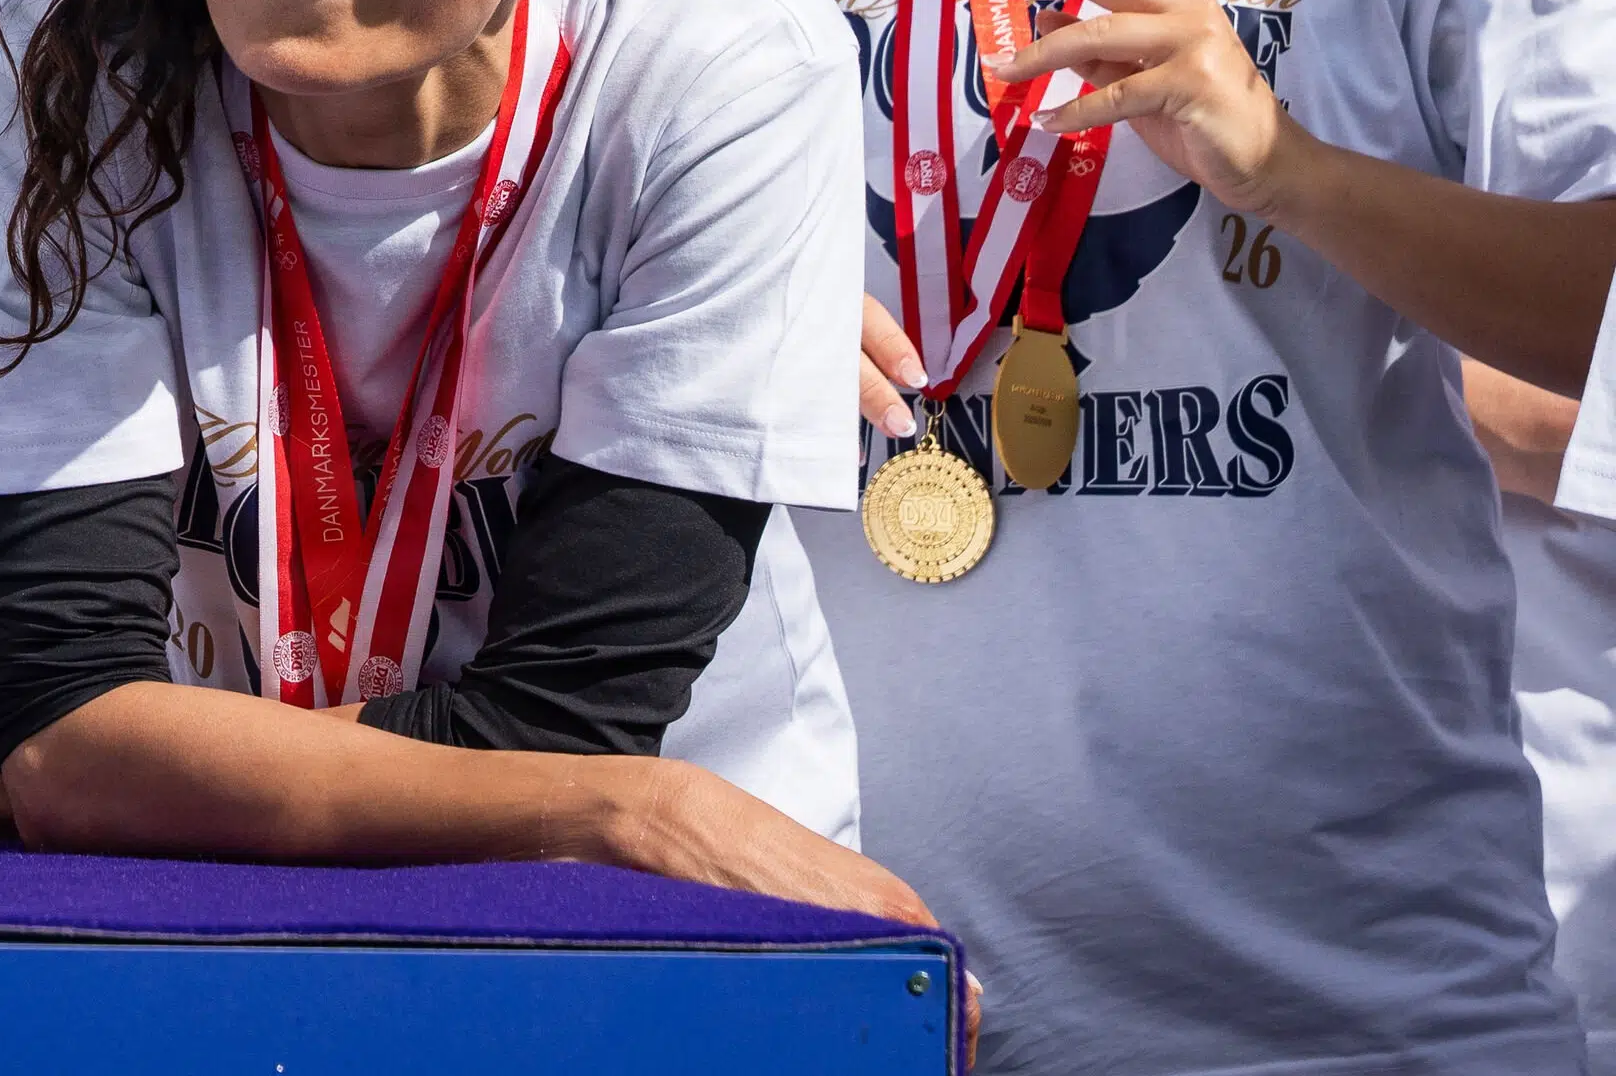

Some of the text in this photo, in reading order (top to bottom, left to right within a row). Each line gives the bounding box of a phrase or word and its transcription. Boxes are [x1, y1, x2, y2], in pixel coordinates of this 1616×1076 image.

[1220, 211, 1282, 290] 26
[293, 320, 345, 542] DANMARKSMESTER
[290, 641, 304, 672] DBU
